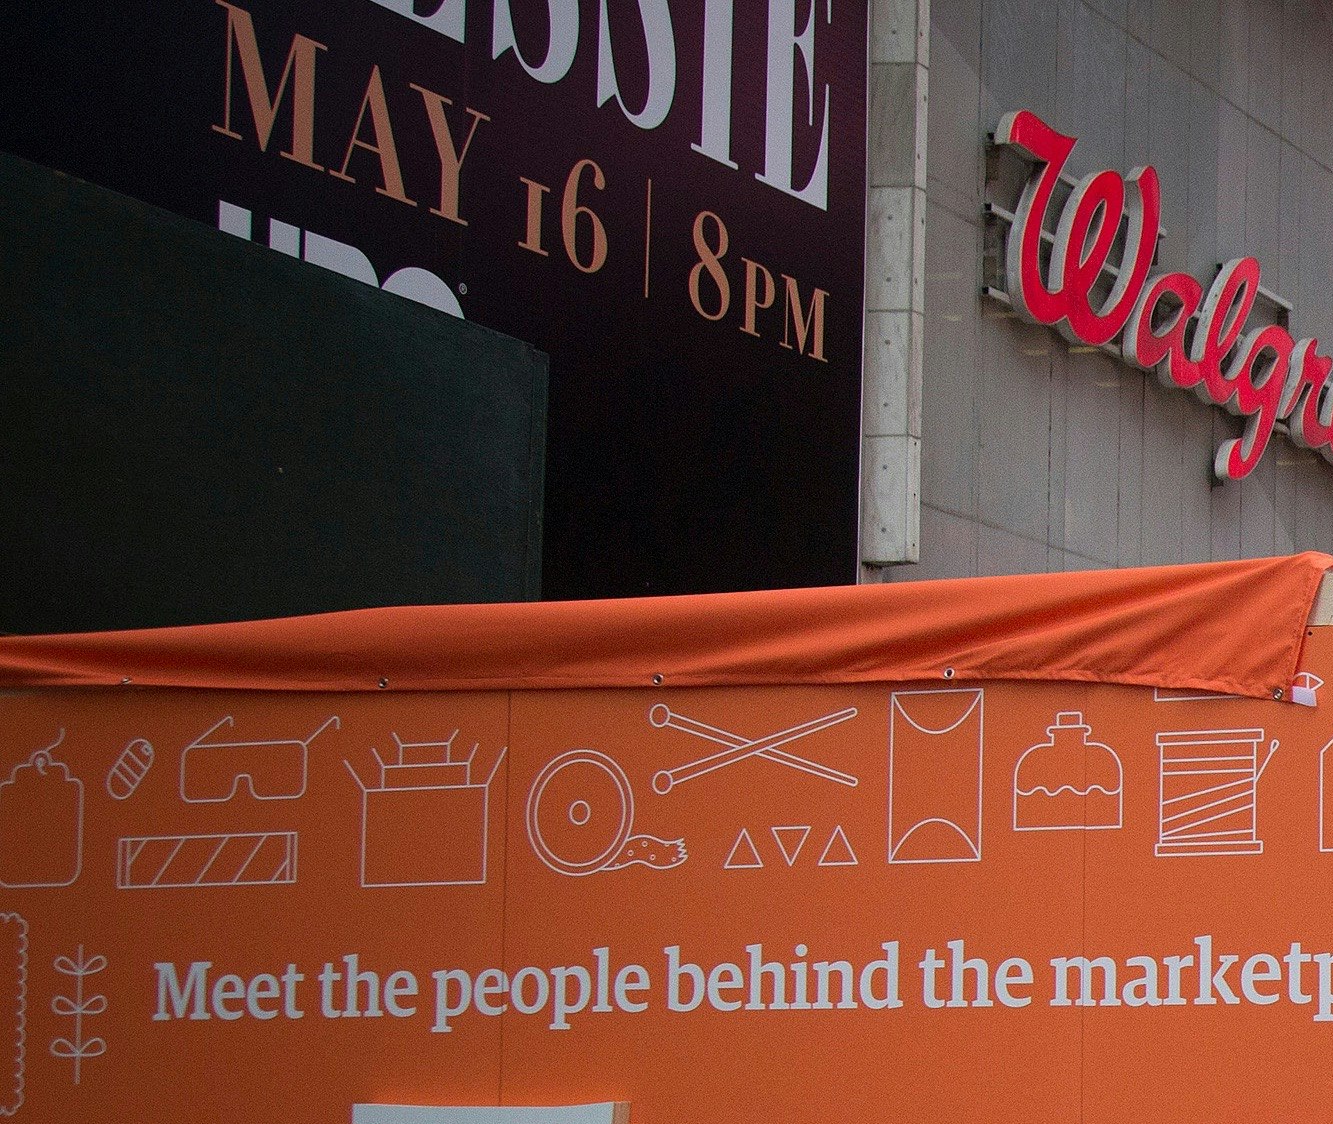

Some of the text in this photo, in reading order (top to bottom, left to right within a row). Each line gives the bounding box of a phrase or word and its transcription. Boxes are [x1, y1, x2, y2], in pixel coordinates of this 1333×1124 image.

[212, 0, 491, 227] MAY
[517, 158, 608, 275] 16
[688, 210, 830, 364] 8PM
[152, 960, 305, 1021] Meet
[317, 953, 418, 1019] the
[431, 946, 650, 1033] people
[664, 940, 904, 1013] behind
[918, 939, 1034, 1008] the
